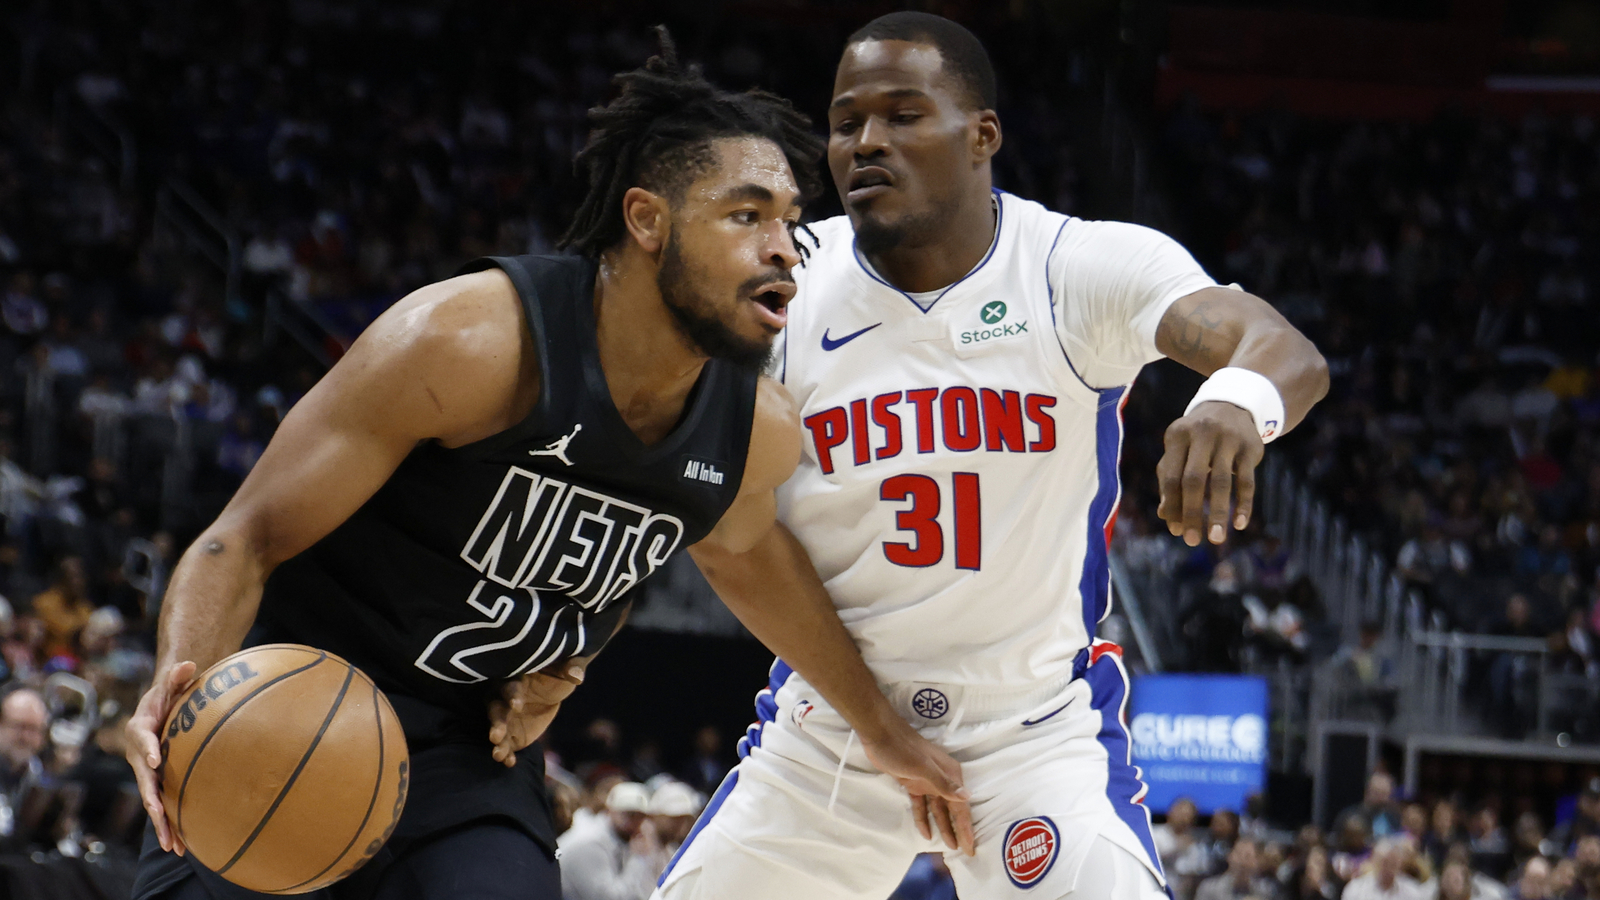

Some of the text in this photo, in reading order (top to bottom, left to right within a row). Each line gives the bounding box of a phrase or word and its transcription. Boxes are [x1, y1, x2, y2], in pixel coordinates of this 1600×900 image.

[961, 320, 1028, 344] StockX
[803, 386, 1057, 475] PISTONS
[683, 460, 700, 479] All
[879, 471, 982, 571] 31
[460, 465, 684, 614] NETS
[1011, 832, 1046, 857] DETROIT
[1013, 844, 1048, 869] PISTONS
